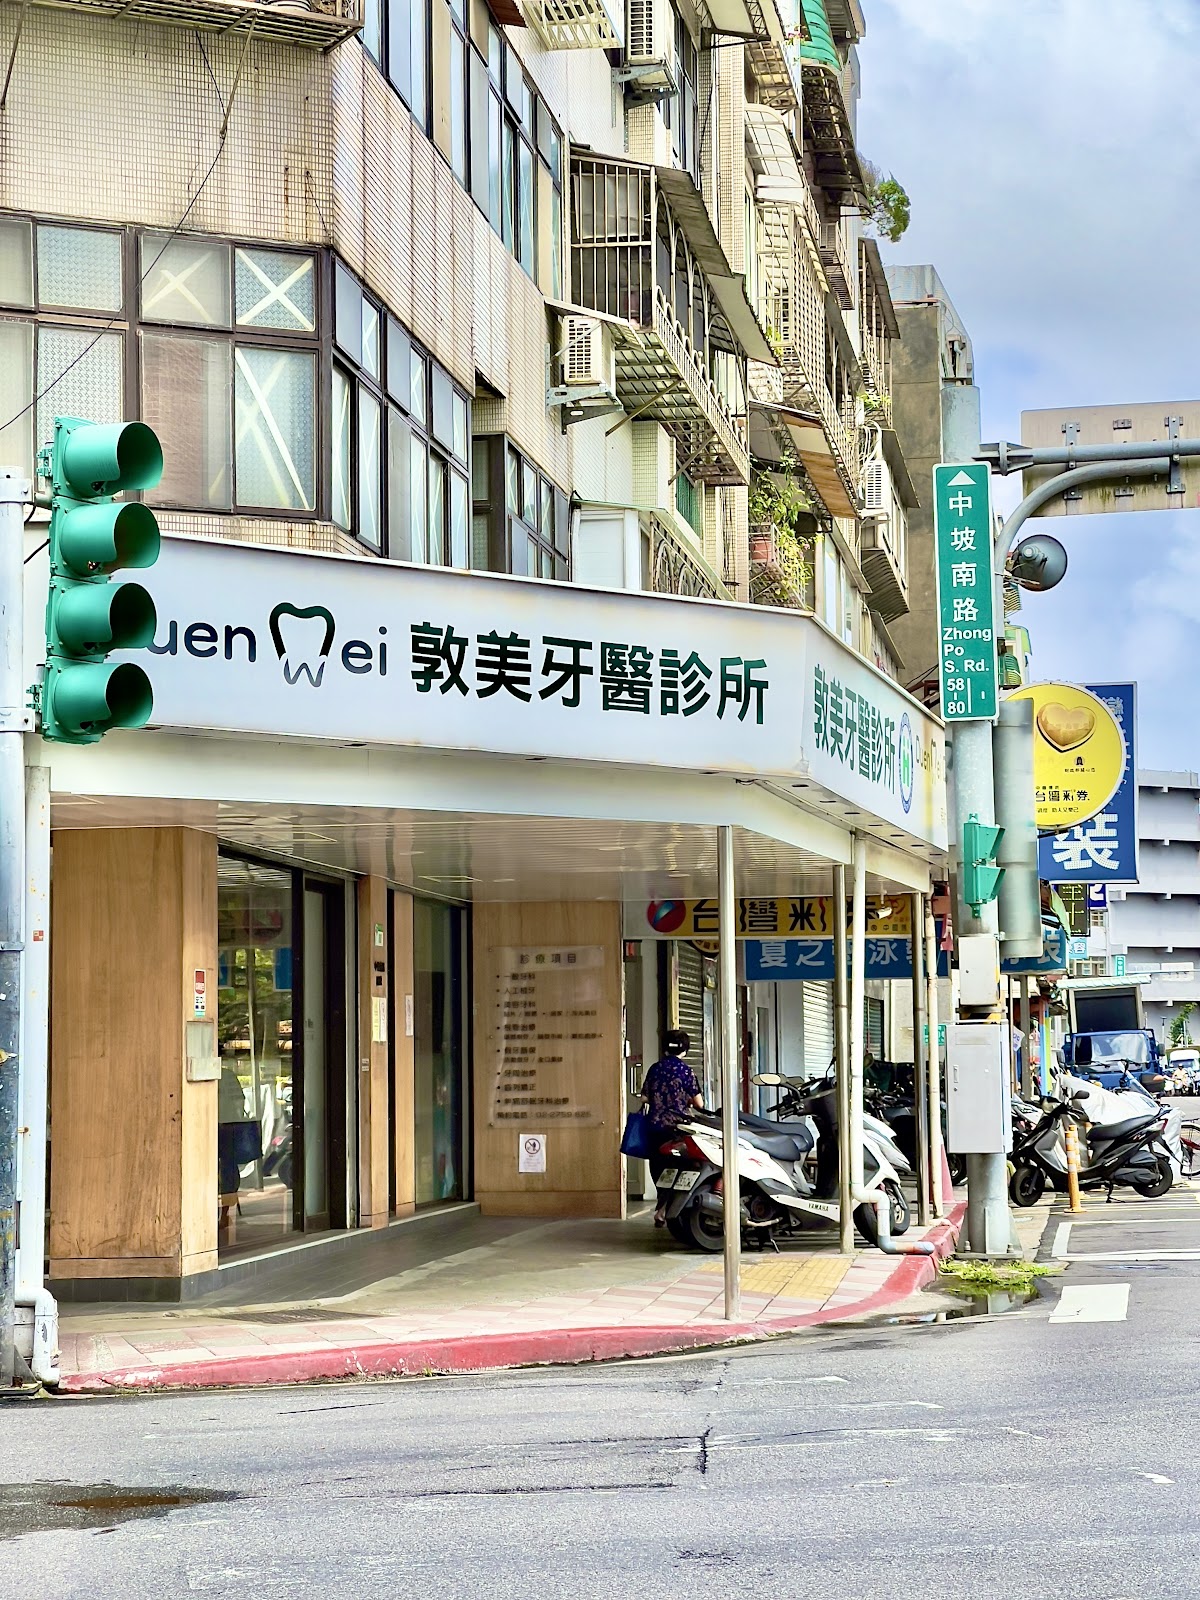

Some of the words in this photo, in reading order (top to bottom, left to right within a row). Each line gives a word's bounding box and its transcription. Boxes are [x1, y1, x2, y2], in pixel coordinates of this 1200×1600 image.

[948, 490, 979, 622] 中坡南路
[943, 627, 992, 643] Zhong
[944, 644, 965, 657] Po
[410, 621, 769, 725] 敦美牙醫診所
[944, 660, 960, 673] S.
[964, 659, 990, 672] Rd.
[947, 678, 965, 692] 58
[947, 700, 966, 714] 80
[814, 663, 896, 795] 敦美牙醫診所
[519, 953, 577, 965] 診療項目
[759, 939, 927, 968] 夏之泳
[504, 986, 536, 995] 人工植牙
[808, 1202, 830, 1212] YAMAHA
